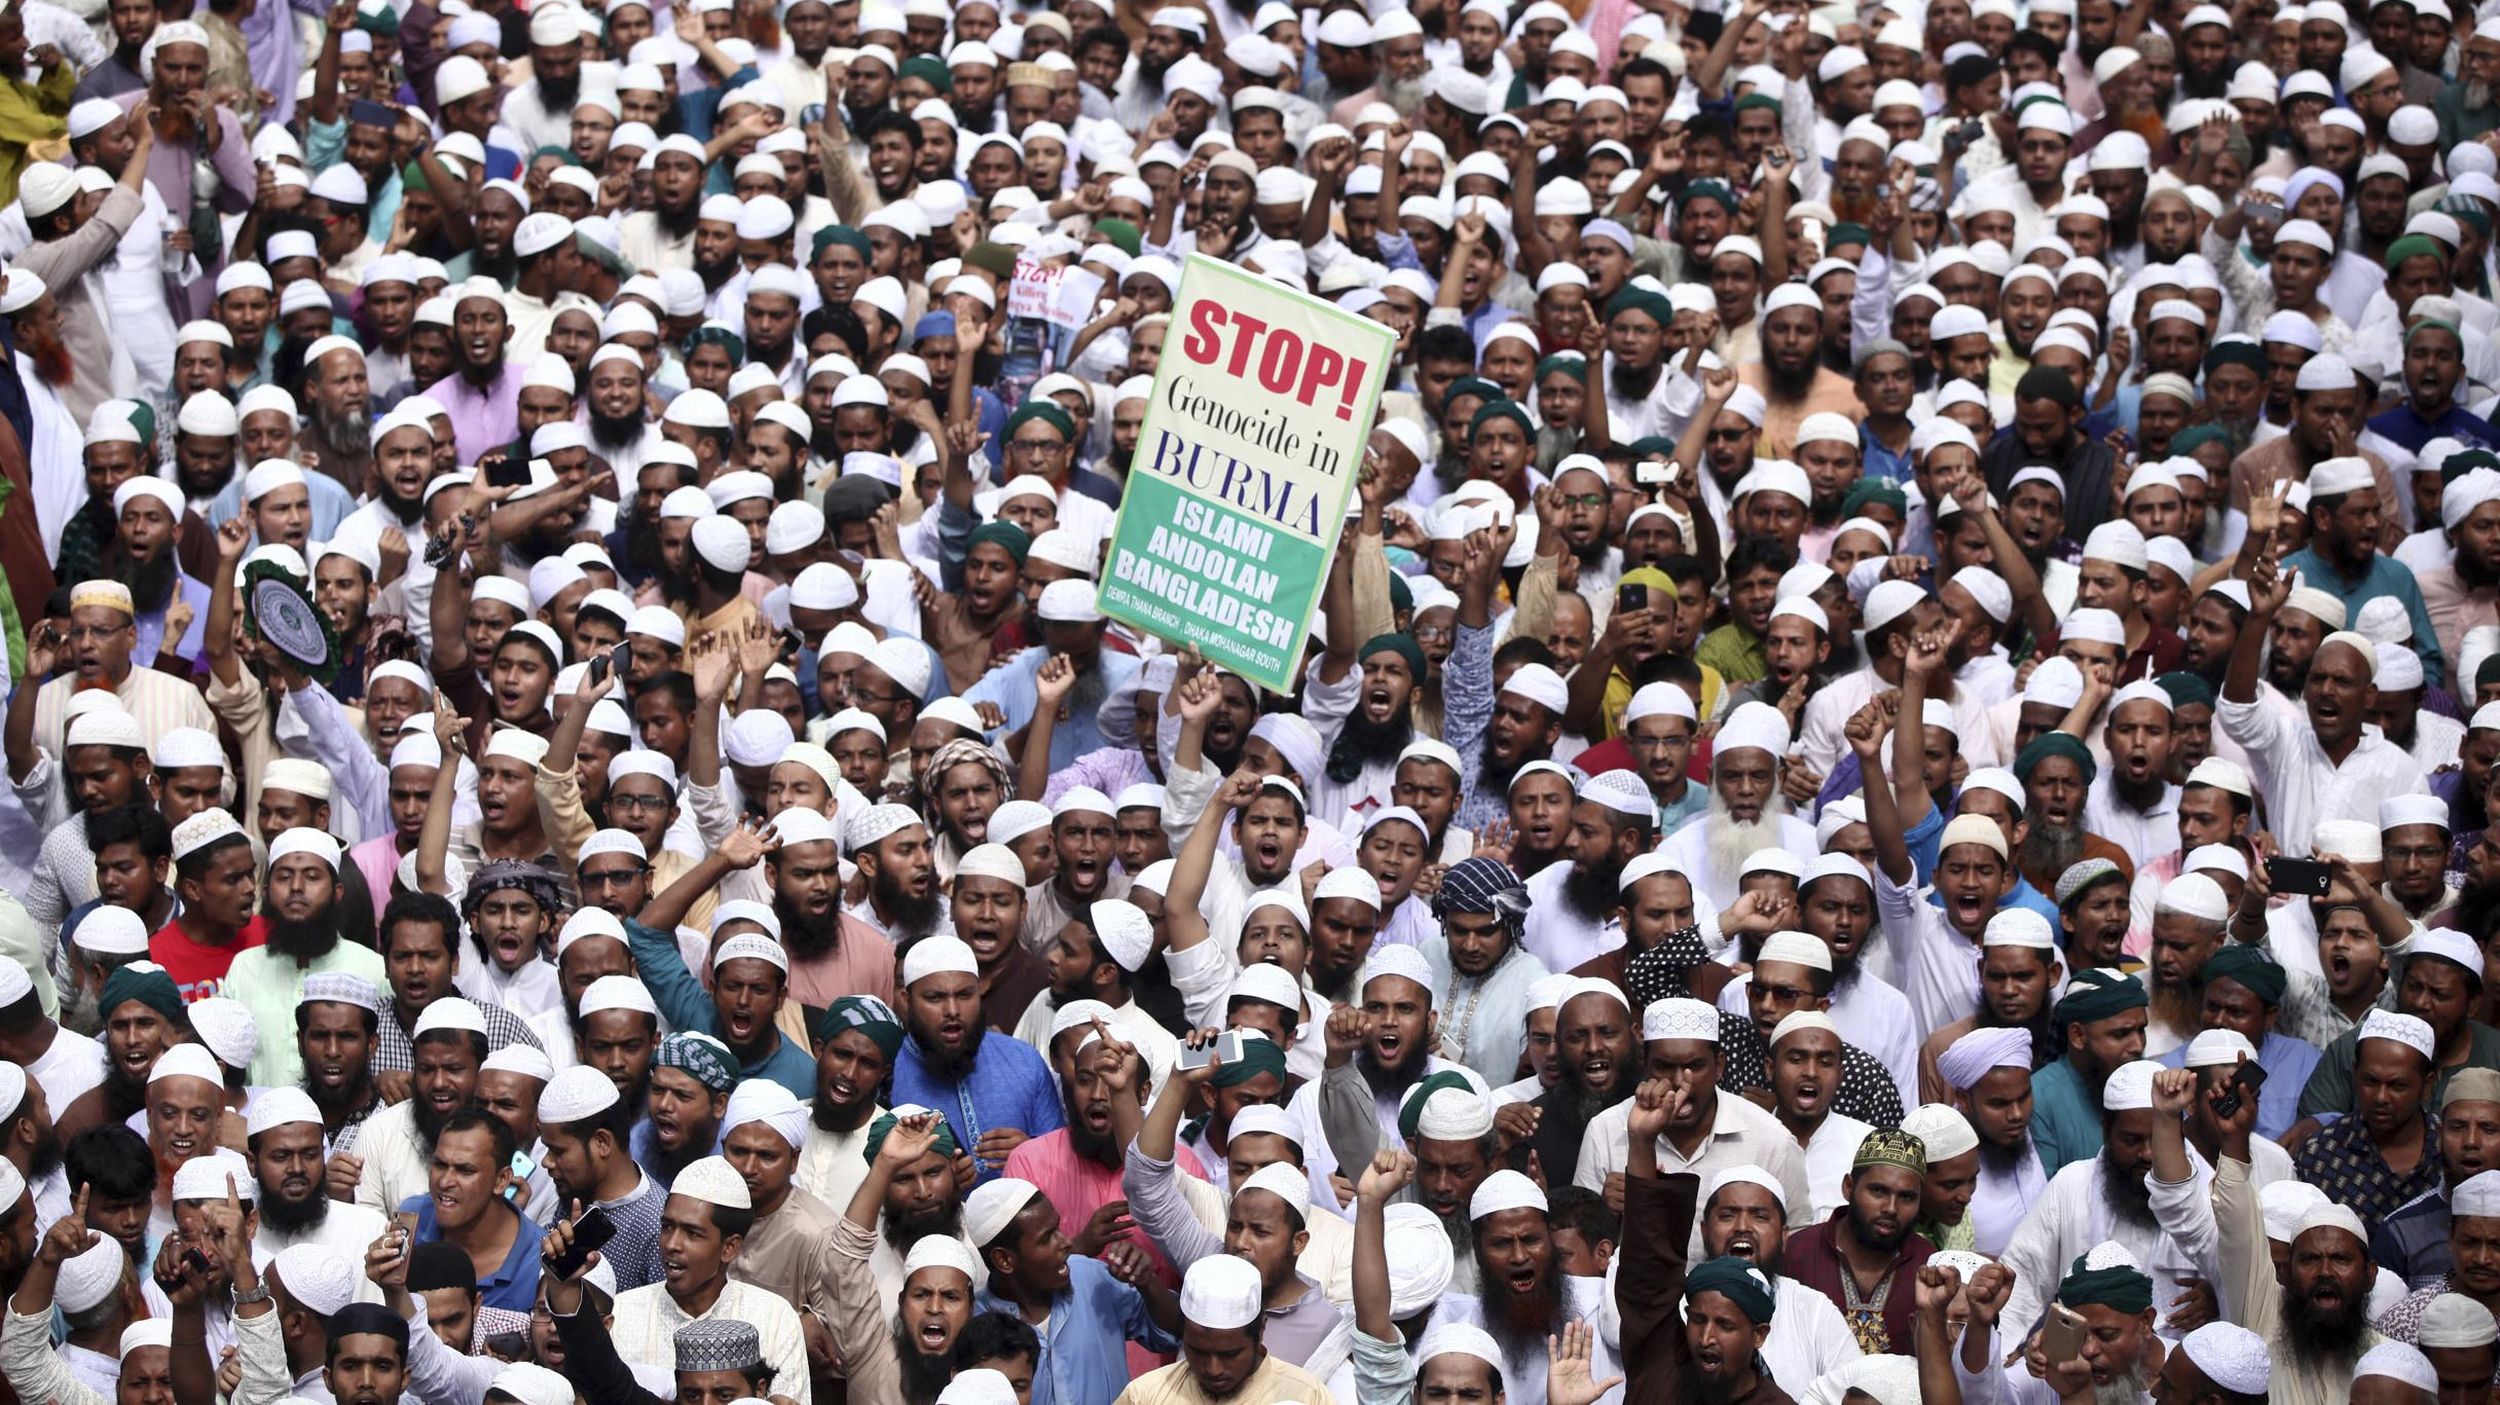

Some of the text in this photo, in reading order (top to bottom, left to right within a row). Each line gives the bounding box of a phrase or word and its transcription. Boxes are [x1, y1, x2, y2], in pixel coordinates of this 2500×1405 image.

[1184, 299, 1367, 421] STOP!
[1168, 374, 1340, 477] Genocide in
[1149, 428, 1323, 540] BURMA
[1172, 495, 1274, 562] ISLAMI
[1114, 548, 1295, 651] BANGLADESH
[1146, 525, 1280, 604] ANDOLAN
[1106, 585, 1131, 602] DEMRA
[1131, 595, 1153, 616] THANA
[1152, 606, 1180, 628] BRANCH
[1184, 621, 1210, 642] DHAKA
[1208, 632, 1256, 663] MOHANAGAR
[1255, 651, 1281, 673] SOUTH
